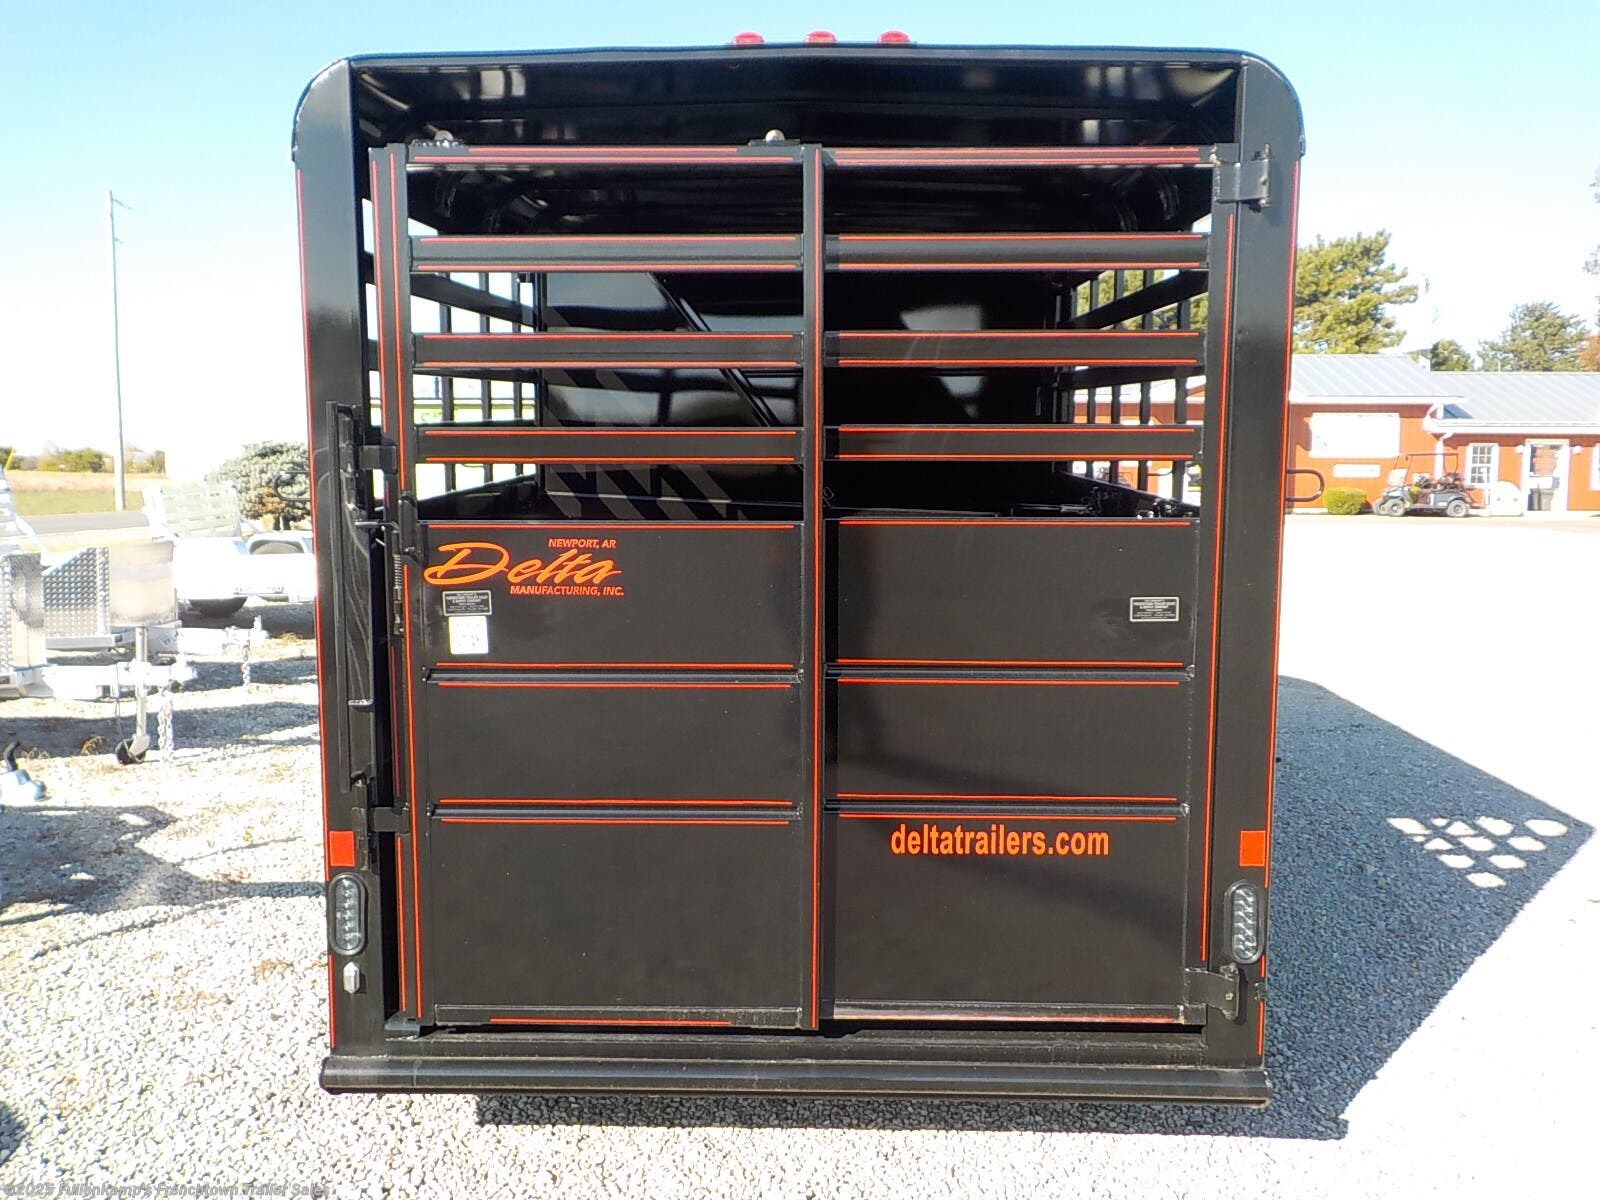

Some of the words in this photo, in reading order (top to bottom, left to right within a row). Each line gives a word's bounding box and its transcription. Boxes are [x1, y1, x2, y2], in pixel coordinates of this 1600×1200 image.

[548, 538, 600, 549] NEWPORT,
[601, 538, 617, 549] AR
[423, 541, 622, 585] Delta
[509, 585, 601, 597] MANUFACTURING,
[602, 586, 625, 597] INC.
[890, 822, 1109, 856] deltatrailers.com
